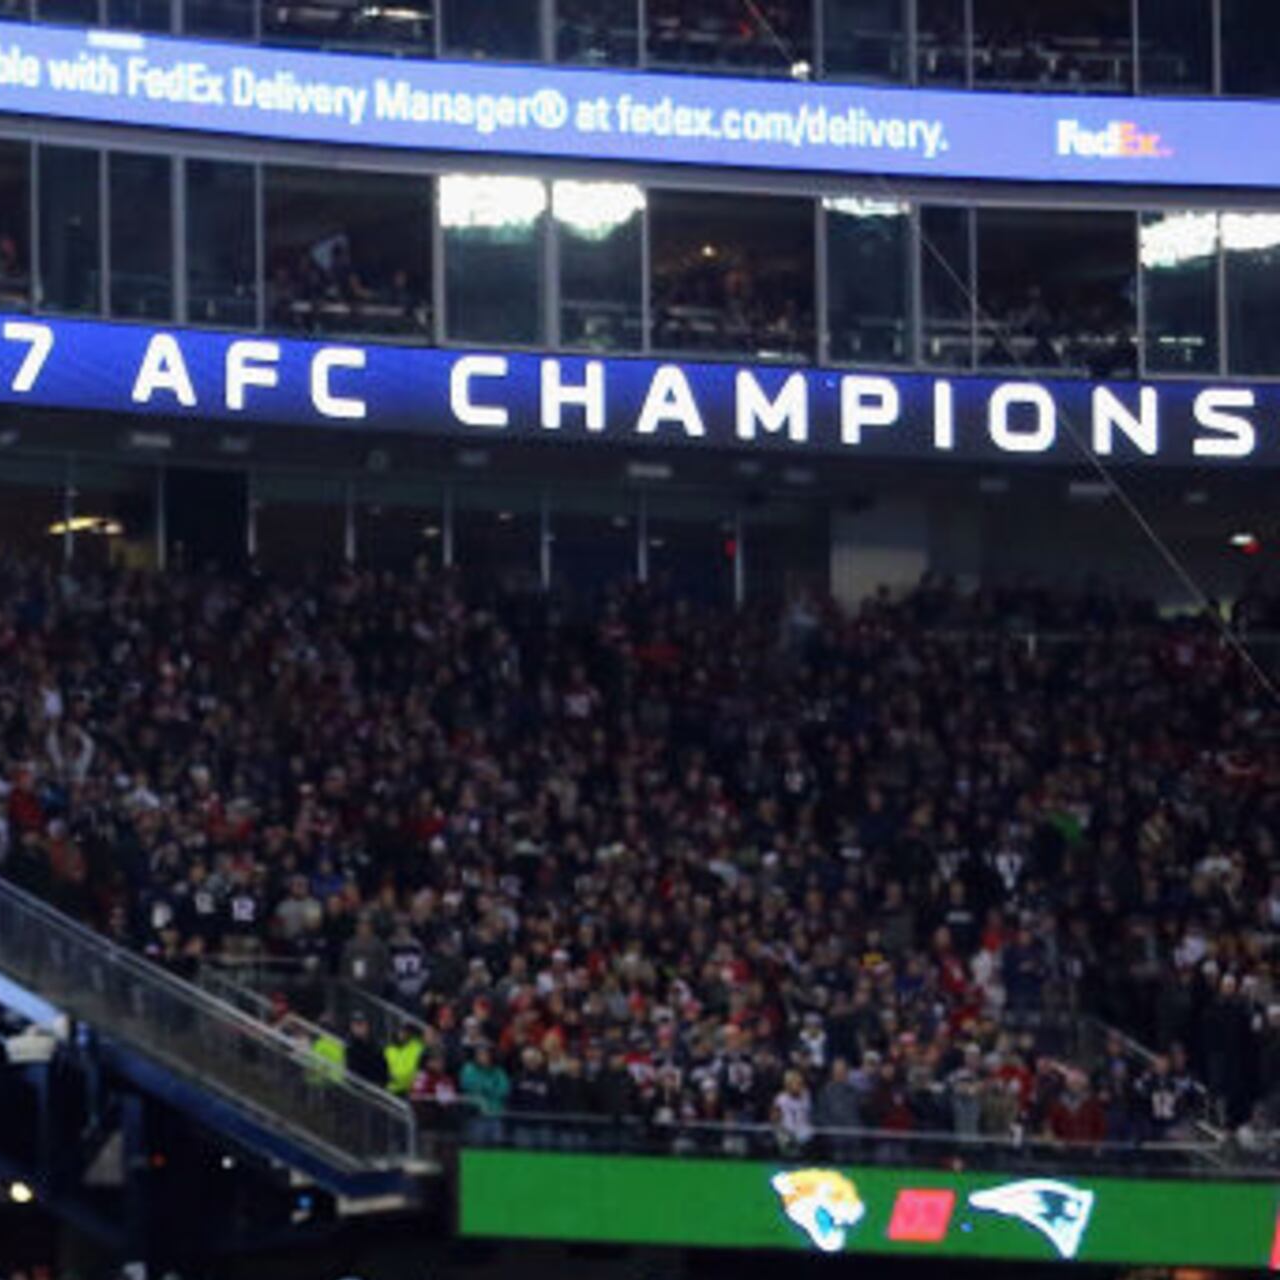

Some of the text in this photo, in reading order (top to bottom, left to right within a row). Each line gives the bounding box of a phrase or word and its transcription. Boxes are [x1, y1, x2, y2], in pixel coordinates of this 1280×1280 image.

[48, 52, 119, 94] with
[127, 58, 225, 104] FedEx
[232, 67, 367, 125] Delivery
[575, 97, 611, 132] at
[618, 93, 949, 159] fedex.com/delivery.
[131, 332, 367, 418] AFC
[449, 355, 1258, 457] CHAMPIONS
